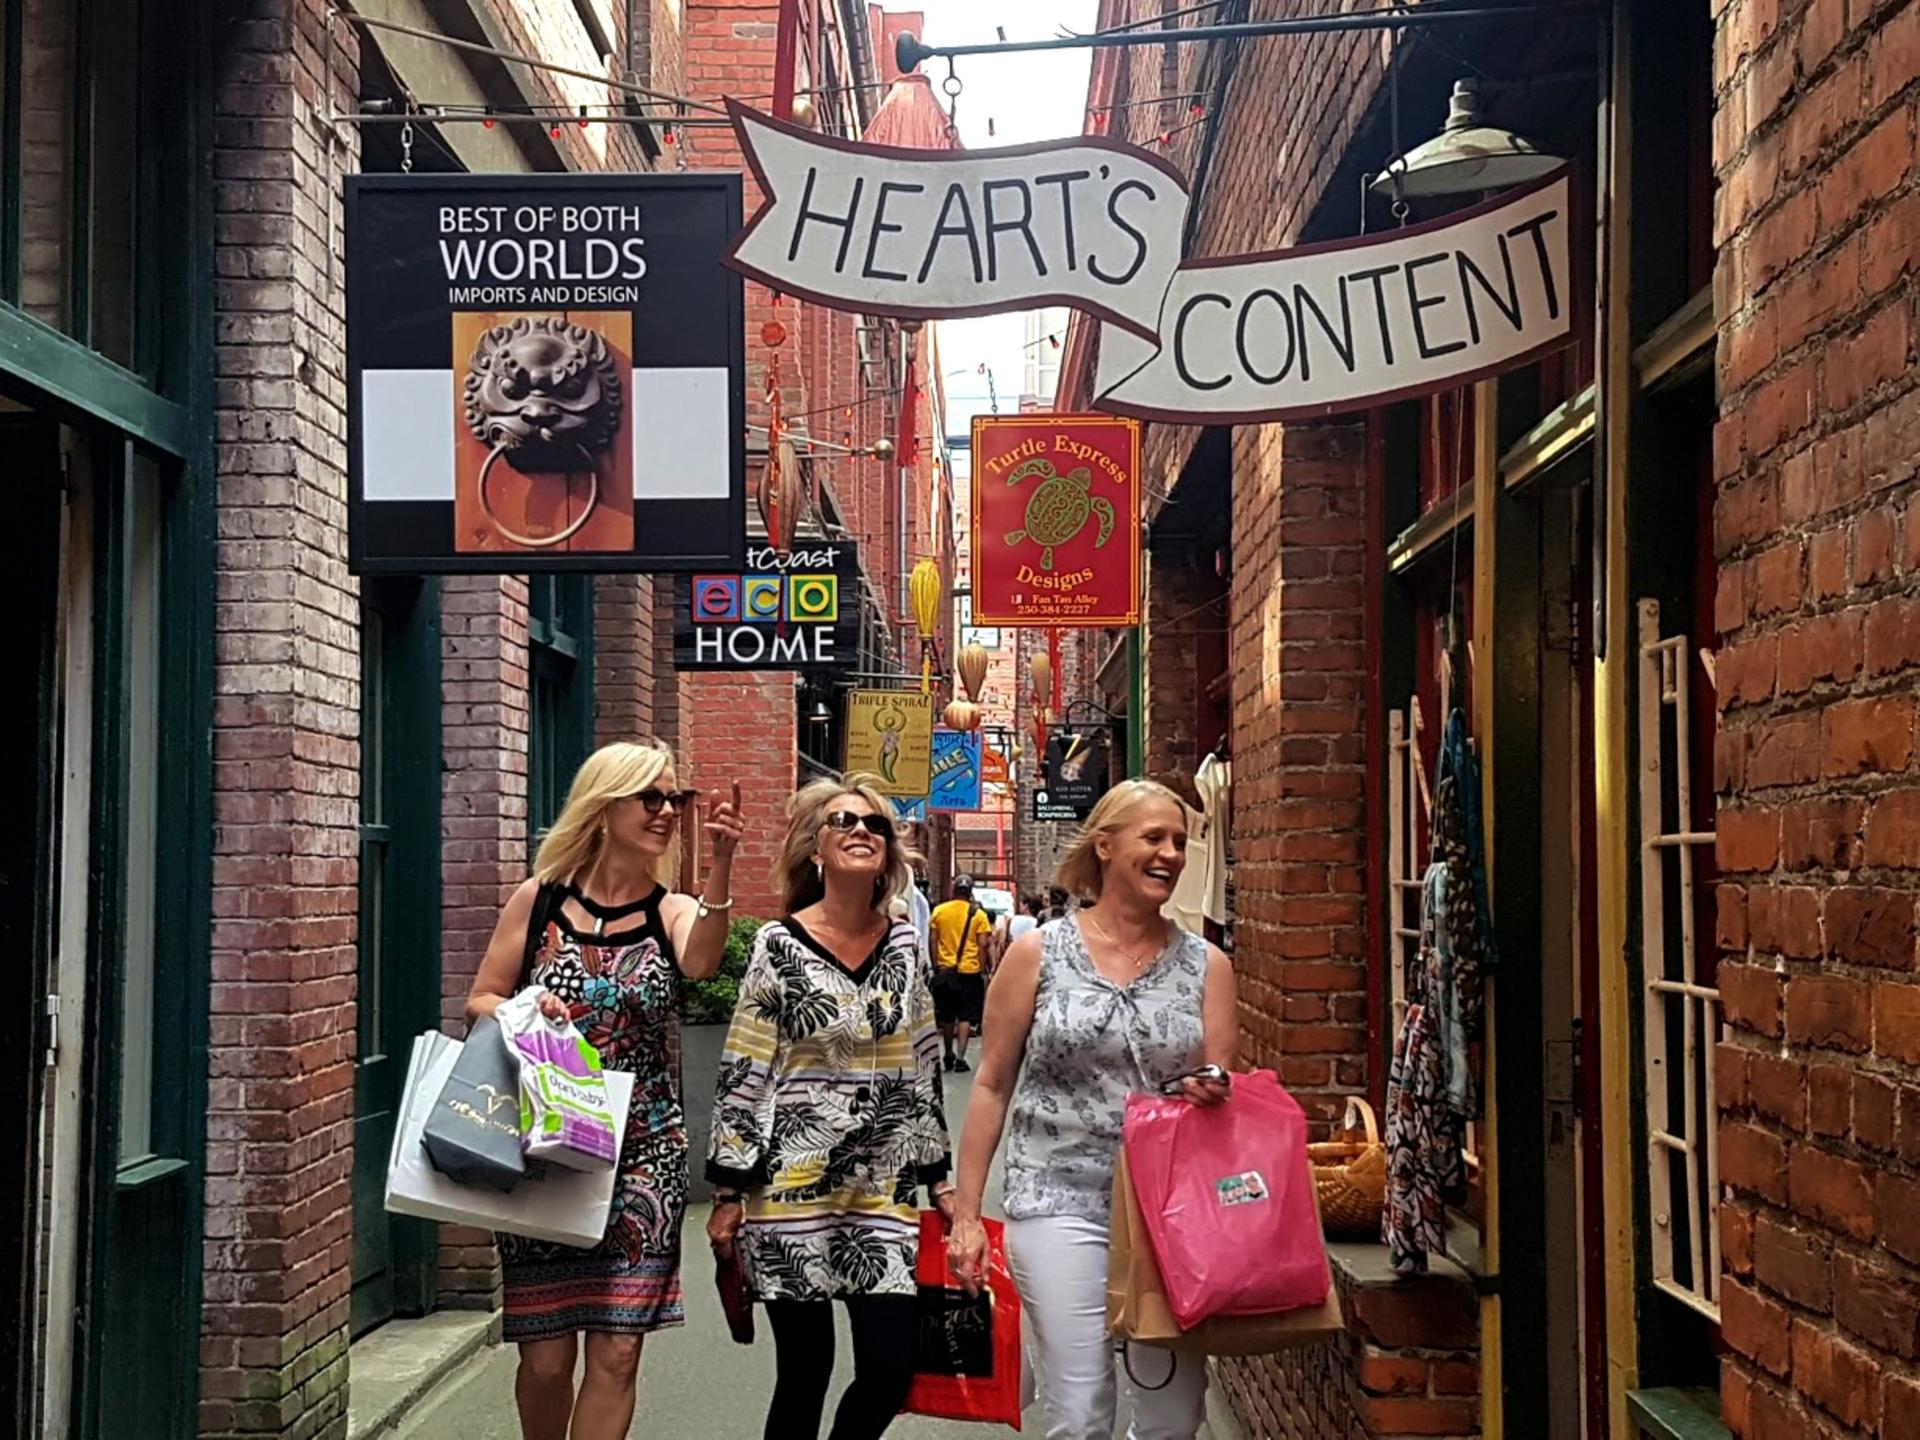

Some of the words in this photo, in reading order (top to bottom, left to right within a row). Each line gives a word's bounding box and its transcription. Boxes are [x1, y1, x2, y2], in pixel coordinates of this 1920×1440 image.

[440, 207, 506, 233] BEST
[515, 207, 554, 233] OF
[563, 206, 640, 232] BOTH
[786, 164, 1157, 286] HEART'S
[439, 238, 648, 281] WORLDS
[448, 287, 526, 304] IMPORTS
[530, 287, 569, 304] AND
[574, 286, 639, 303] DESIGN
[1172, 209, 1561, 391] CONTENT
[985, 436, 1047, 476] Turtle
[1053, 435, 1128, 484] Express
[1015, 565, 1094, 591] Designs
[1032, 595, 1052, 605] Fan
[1054, 595, 1073, 605] Tan
[1074, 595, 1099, 606] Alley
[695, 626, 836, 663] HOME
[852, 693, 889, 706] TRIPLE
